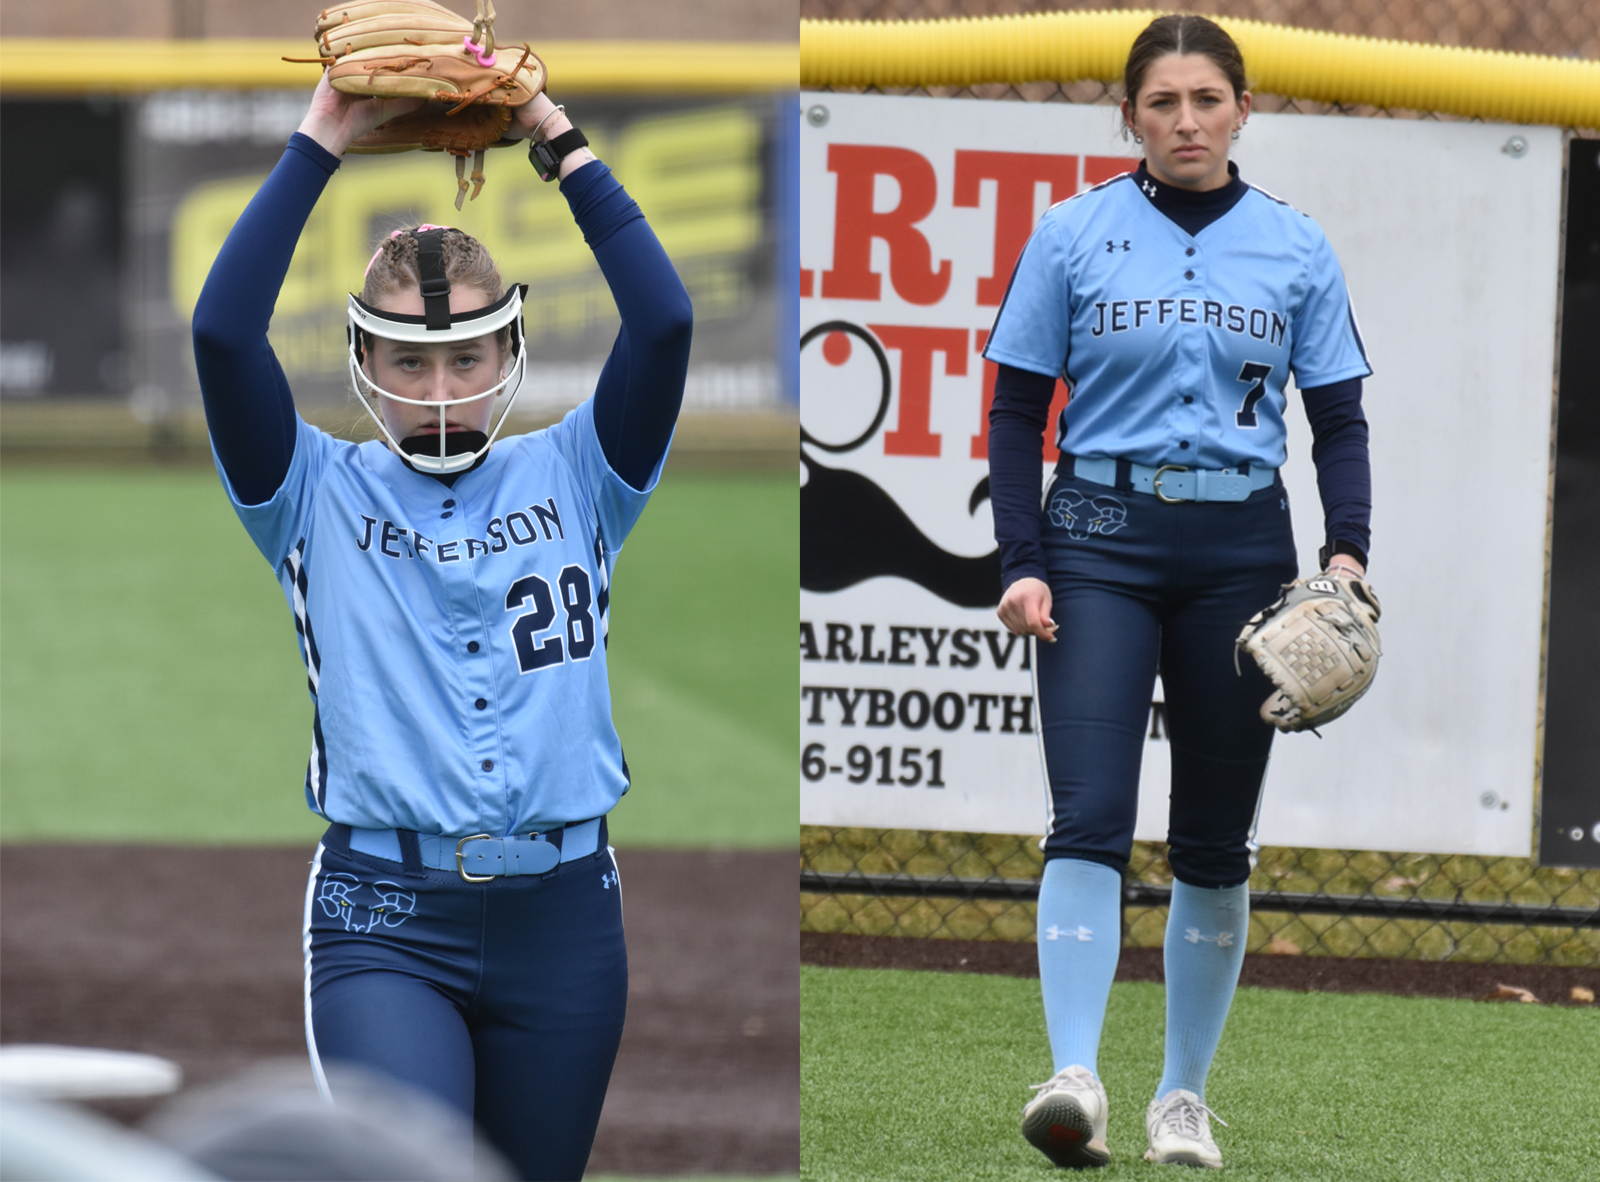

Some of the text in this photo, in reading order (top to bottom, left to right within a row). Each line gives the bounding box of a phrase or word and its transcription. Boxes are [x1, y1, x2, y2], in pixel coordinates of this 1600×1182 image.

[800, 142, 1143, 307] RT
[1091, 298, 1287, 347] JEFFERSON
[1236, 360, 1273, 428] 7
[504, 563, 596, 676] 28
[800, 742, 946, 788] 6-9151
